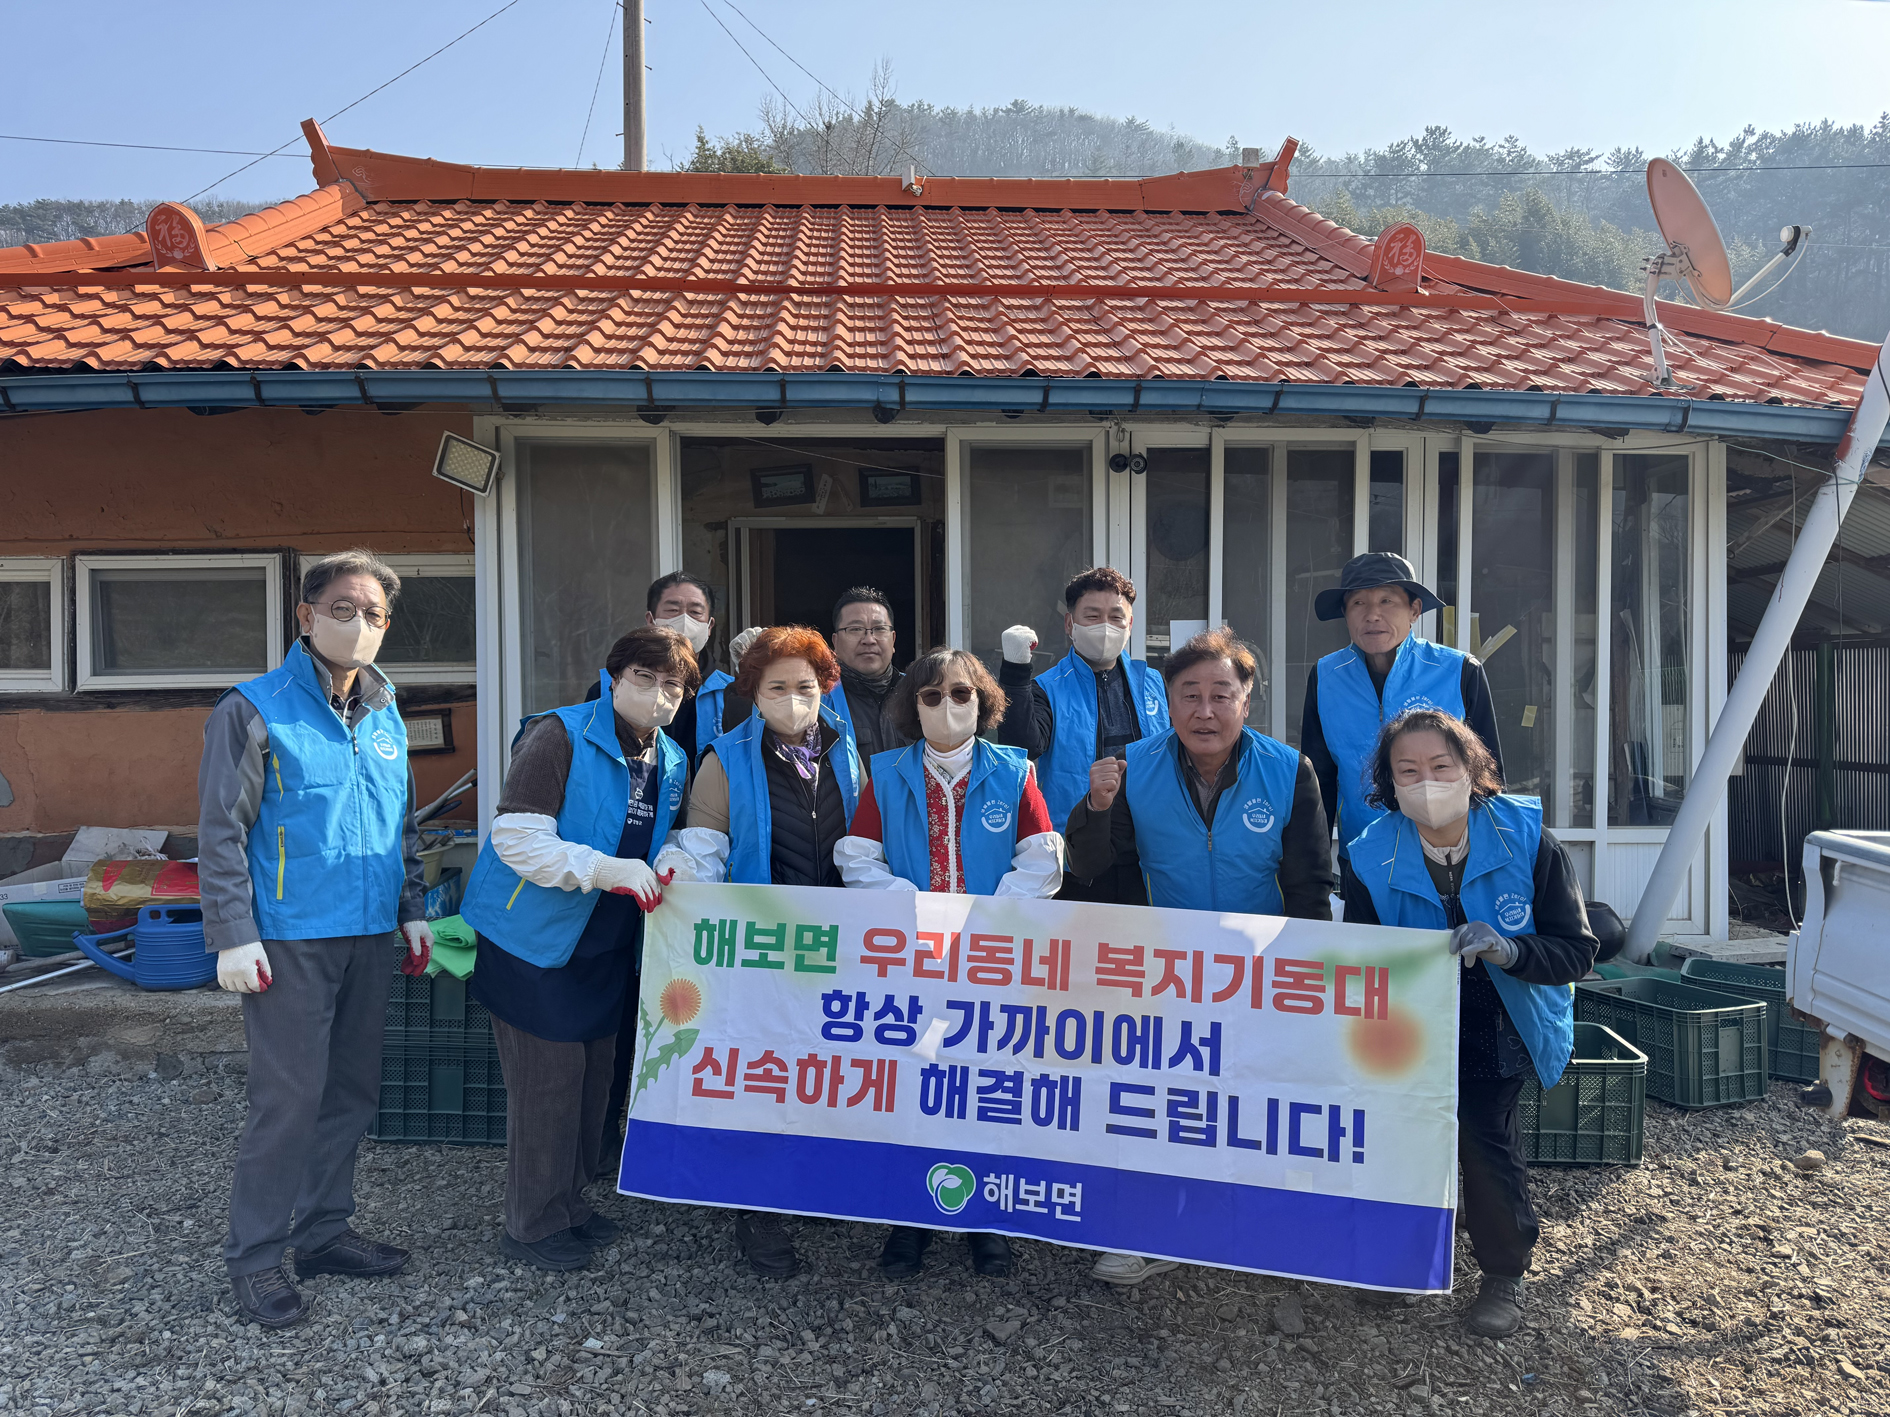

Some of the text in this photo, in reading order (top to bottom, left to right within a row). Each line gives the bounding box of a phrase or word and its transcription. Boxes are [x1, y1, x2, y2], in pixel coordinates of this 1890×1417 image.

[693, 918, 840, 975] 해보면
[859, 926, 1072, 992] 우리동네
[1094, 941, 1390, 1021] 복지기동대
[820, 989, 1222, 1077] 항상 가까이에서
[691, 1046, 1366, 1164] 신속하게 해결해 드립니다!
[983, 1172, 1083, 1222] 해보면
